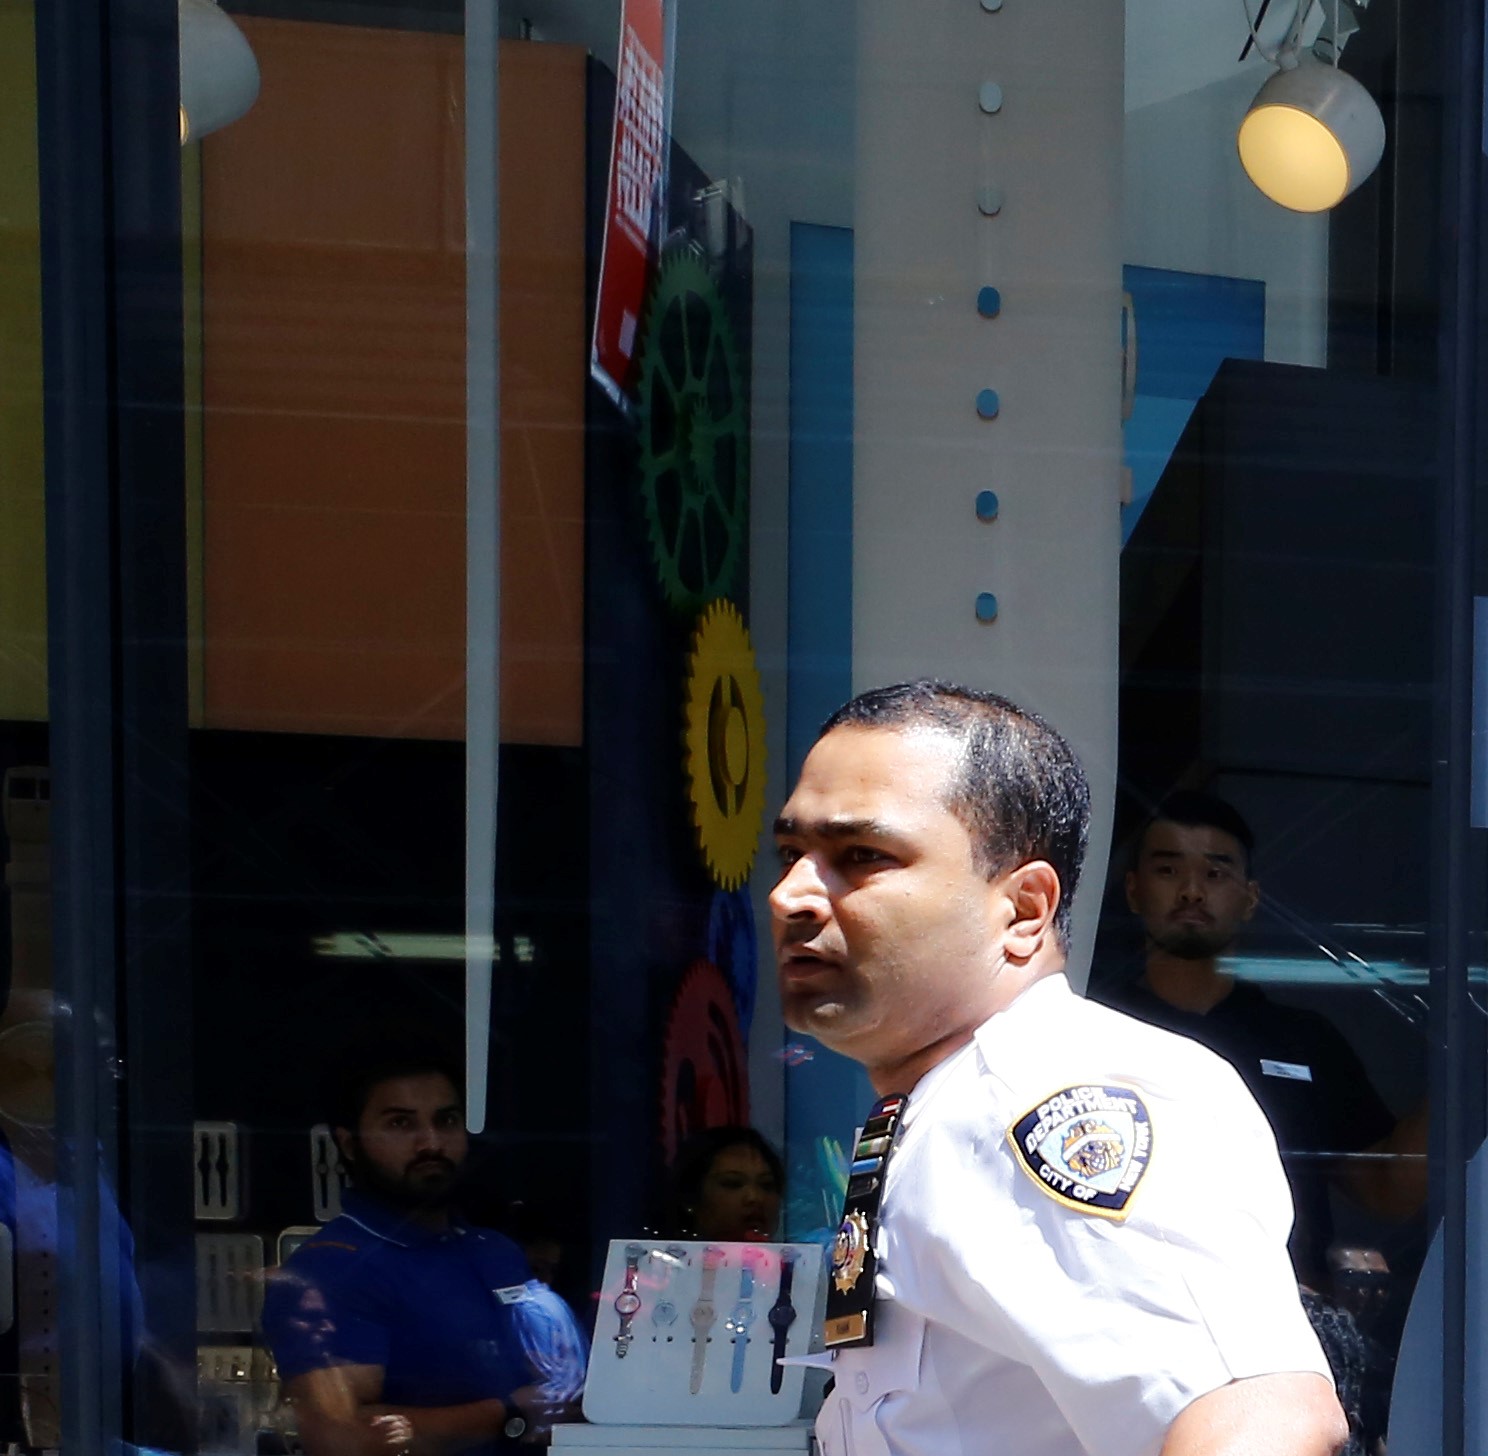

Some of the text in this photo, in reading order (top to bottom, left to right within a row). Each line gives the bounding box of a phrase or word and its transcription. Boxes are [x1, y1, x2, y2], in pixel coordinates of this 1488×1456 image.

[1036, 1086, 1107, 1121] POLICE
[1025, 1097, 1138, 1155] DEPARTMENT
[1038, 1163, 1072, 1192] CITY
[1072, 1184, 1098, 1201] OF
